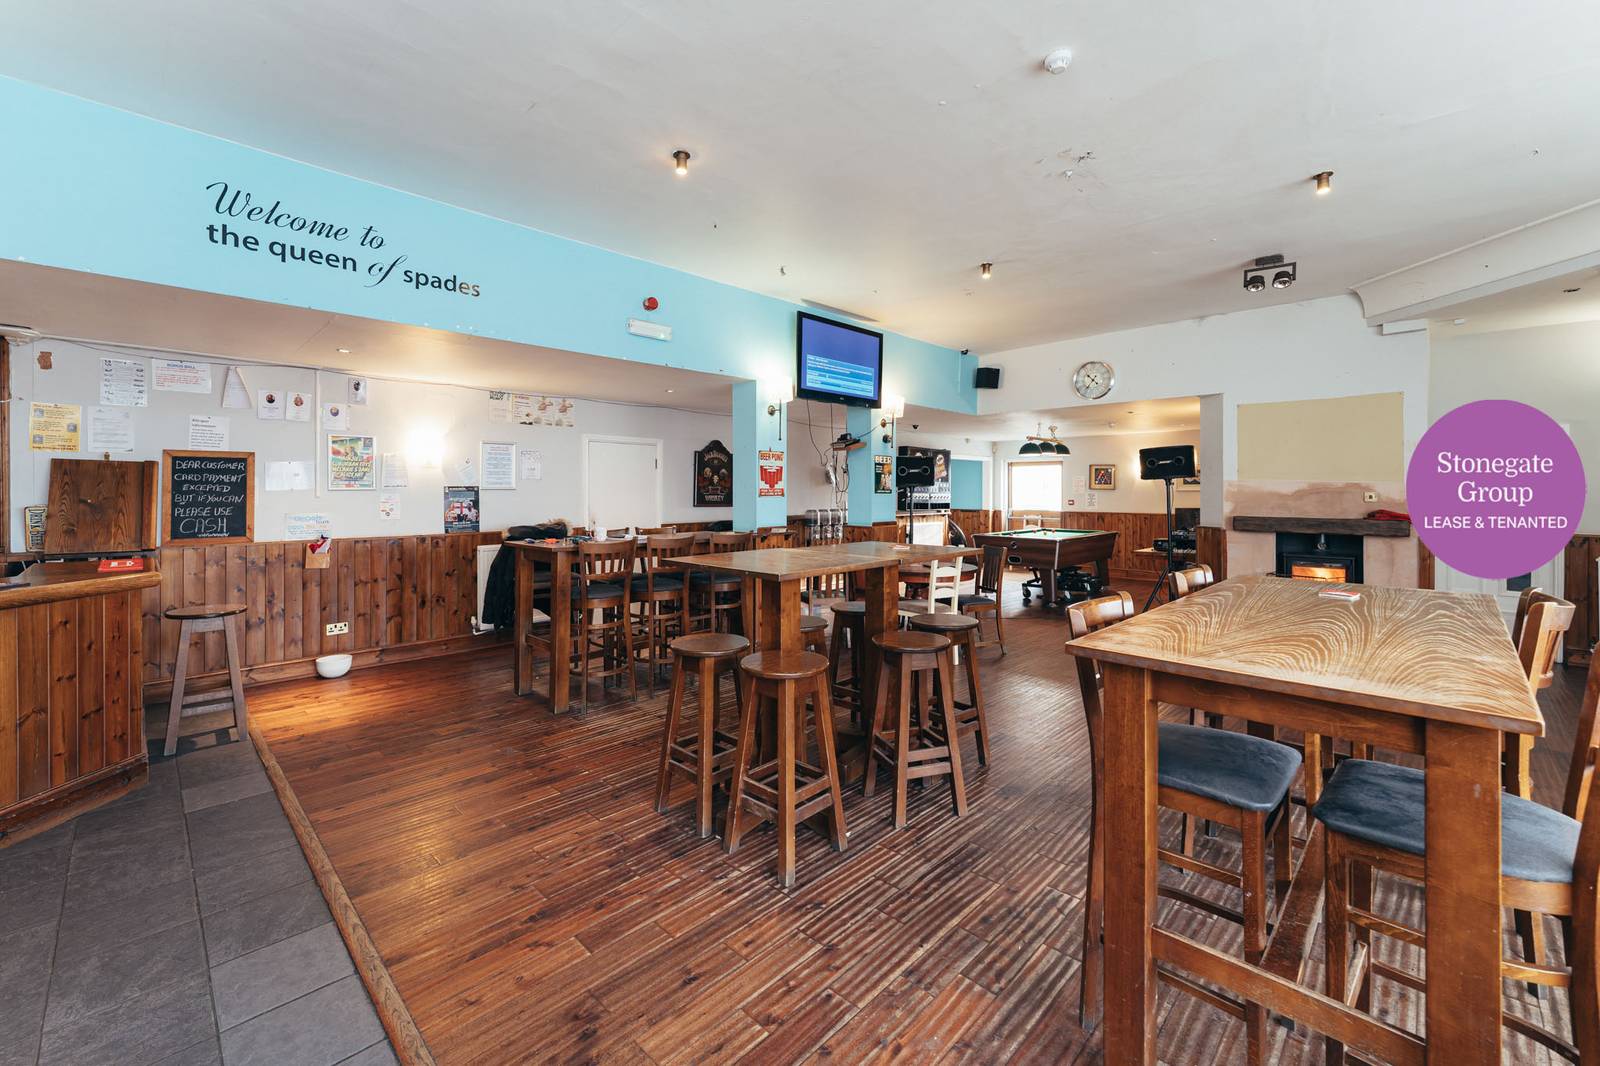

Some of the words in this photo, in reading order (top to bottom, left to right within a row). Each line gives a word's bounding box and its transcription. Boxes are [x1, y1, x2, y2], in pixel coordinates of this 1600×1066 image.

[206, 181, 351, 241] Welcome
[359, 225, 386, 250] to
[206, 223, 260, 252] the
[268, 238, 358, 273] queen
[363, 254, 408, 288] of
[403, 268, 481, 298] spades
[875, 455, 892, 464] BEER
[175, 460, 201, 469] DEAR
[201, 460, 245, 471] CUSTOMER
[174, 473, 203, 481] CARD
[203, 473, 245, 483] PAYMENT
[174, 493, 195, 503] BUT
[222, 494, 245, 503] CAN
[174, 506, 212, 517] PLEASE
[214, 506, 234, 516] USE
[180, 517, 227, 534] CASH
